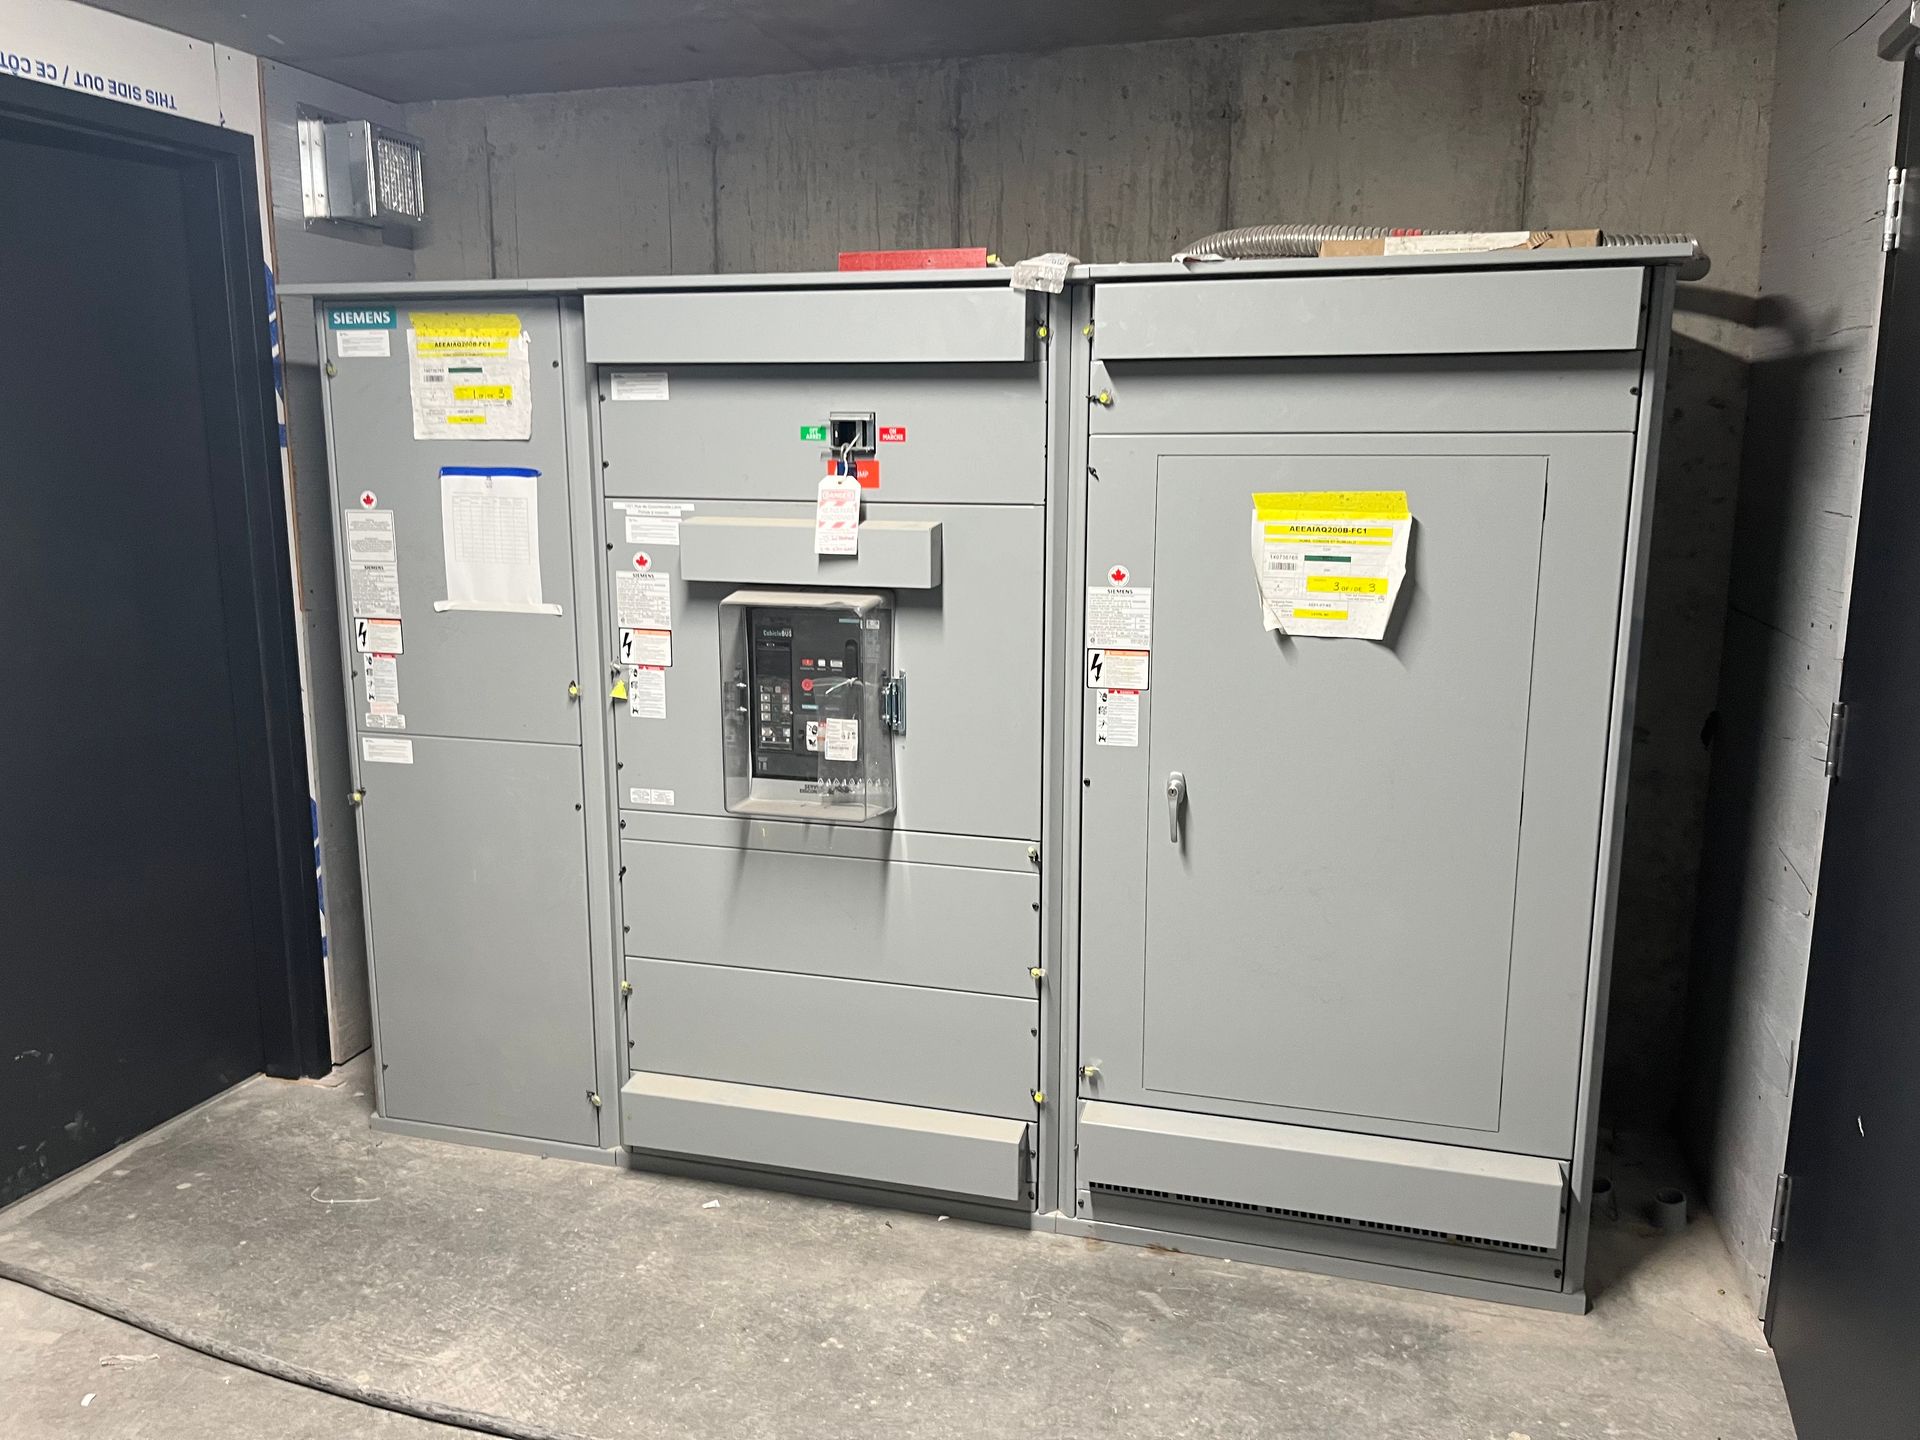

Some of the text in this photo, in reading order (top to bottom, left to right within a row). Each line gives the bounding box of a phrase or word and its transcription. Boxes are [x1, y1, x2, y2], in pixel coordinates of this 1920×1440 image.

[35, 60, 57, 80] CE
[62, 65, 69, 85] /
[73, 70, 104, 92] OUT
[108, 79, 142, 101] SIDE
[146, 89, 178, 110] THIS
[333, 311, 391, 324] SIEMENS
[1289, 526, 1367, 534] AEEAIAQ200B-FC1
[1333, 582, 1340, 591] 3
[1368, 583, 1376, 592] 3
